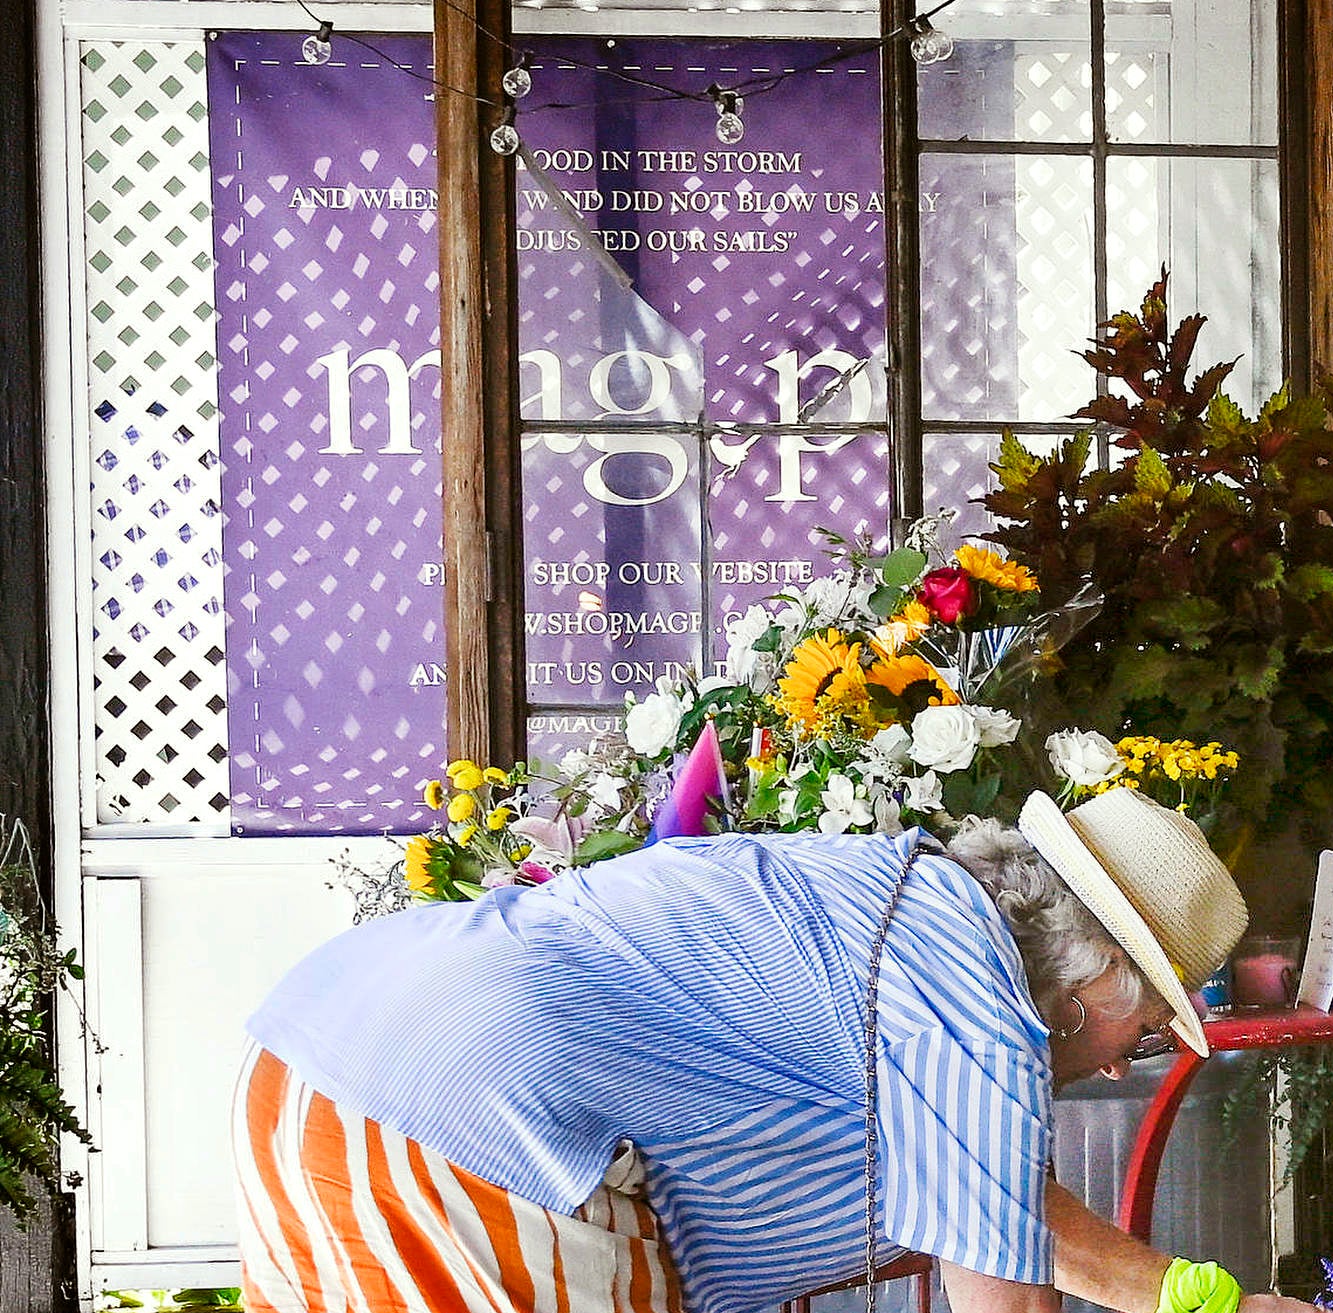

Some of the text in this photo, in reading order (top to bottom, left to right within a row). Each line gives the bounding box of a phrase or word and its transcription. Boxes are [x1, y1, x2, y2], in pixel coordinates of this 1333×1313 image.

[602, 151, 631, 171] IN
[639, 152, 698, 172] THE
[704, 152, 802, 173] STORM
[288, 188, 352, 210] AND
[522, 190, 604, 214] WND
[612, 191, 663, 212] DID
[671, 192, 731, 214] NOT
[737, 192, 820, 213] BLOW
[824, 193, 860, 213] US
[647, 231, 707, 252] OUR
[533, 562, 610, 586] SHOP
[618, 563, 685, 586] OUR
[566, 662, 604, 685] US
[611, 662, 654, 685] ON
